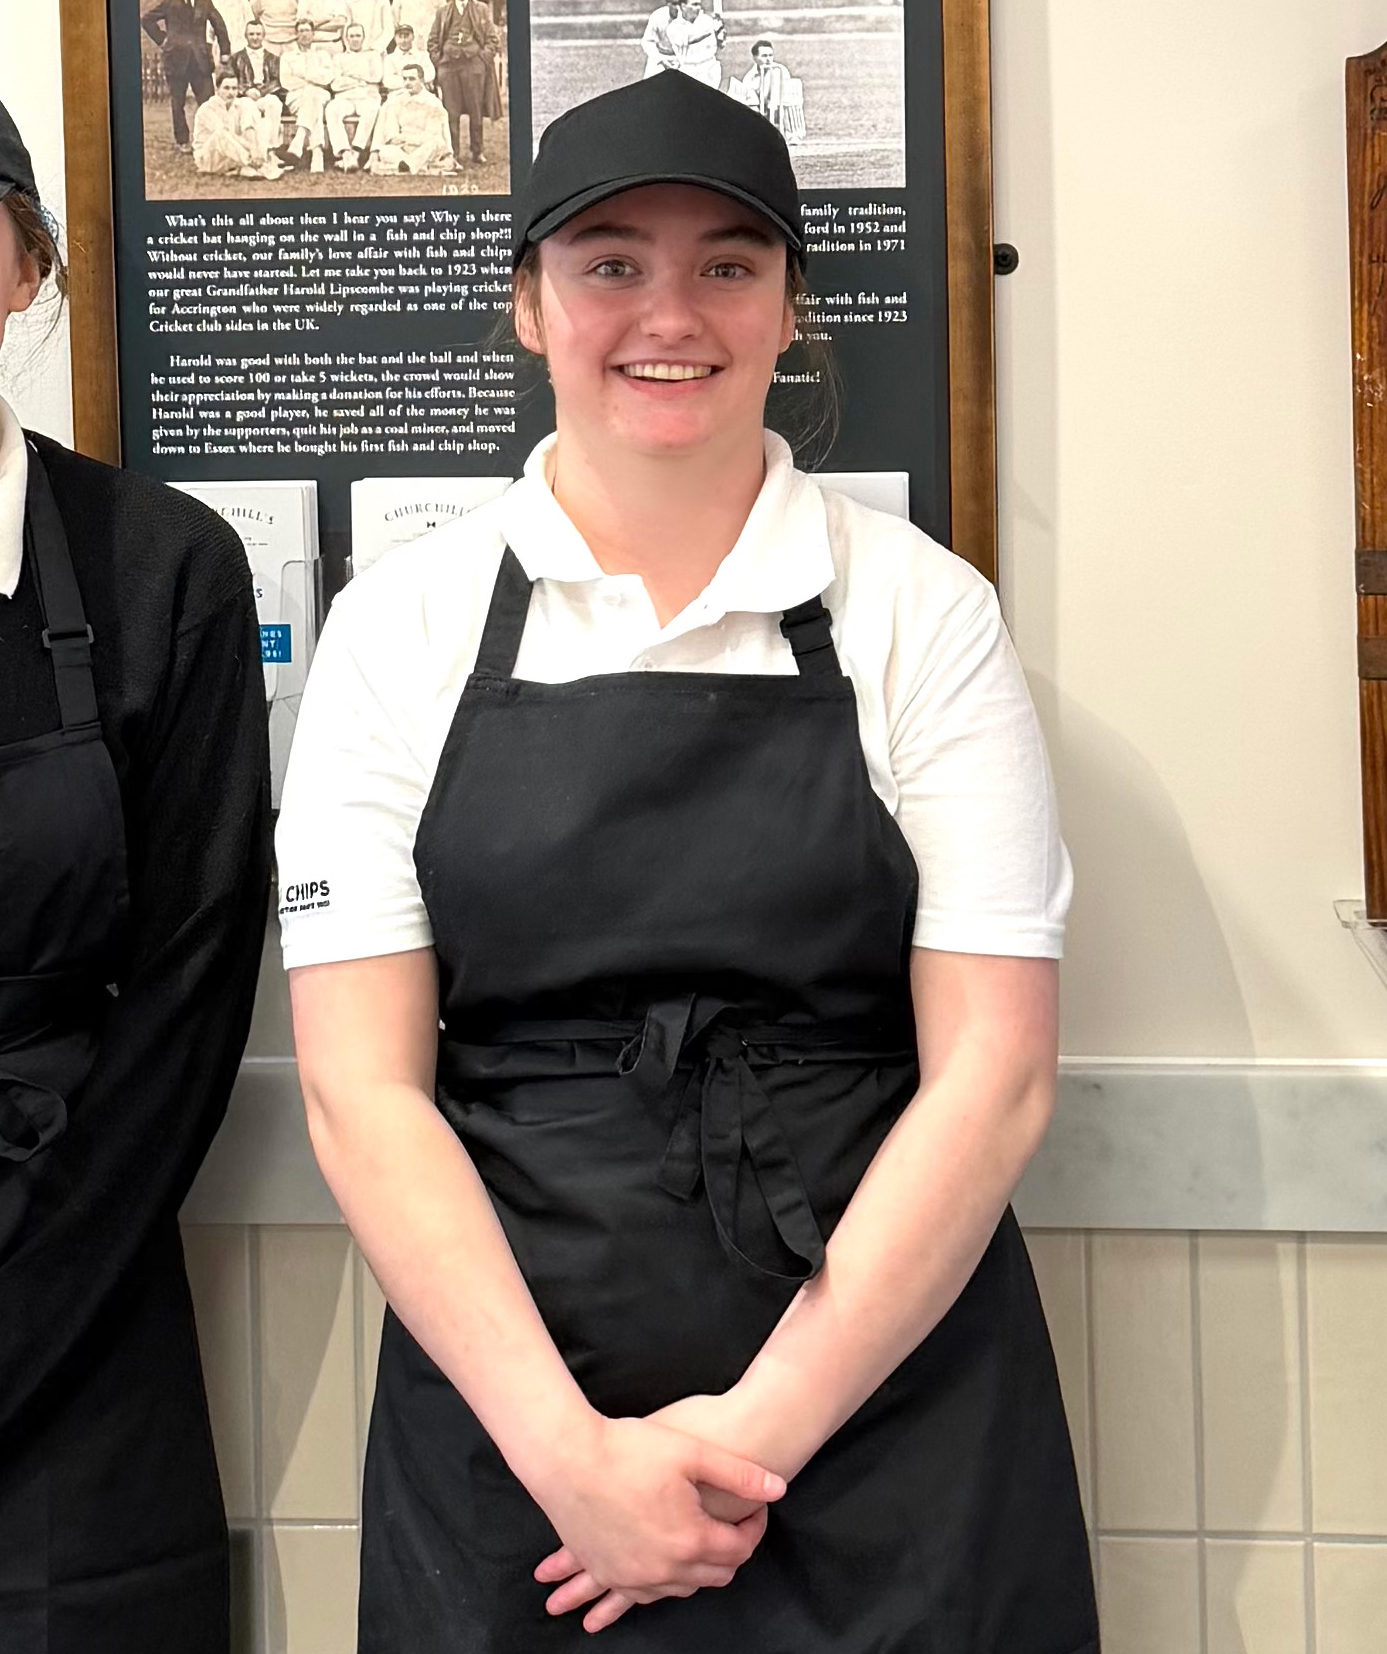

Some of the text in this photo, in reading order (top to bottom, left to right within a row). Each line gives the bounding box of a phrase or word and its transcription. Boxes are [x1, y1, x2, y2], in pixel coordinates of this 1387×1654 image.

[800, 202, 905, 219] family tradition,
[833, 222, 845, 233] in
[850, 221, 880, 233] 1952
[883, 220, 906, 232] and
[859, 239, 871, 251] in
[877, 239, 904, 251] 1971
[146, 245, 512, 263] Without cricket, our family's love affair with fish and chips
[147, 262, 512, 279] would never have started. Let me take you back to 1923 when
[148, 280, 512, 300] our great Grandfather Harold Lipscombe was playing cricket
[825, 292, 852, 305] with
[857, 291, 879, 304] fish
[884, 291, 907, 304] and
[844, 312, 874, 323] since
[878, 310, 907, 322] 1923
[773, 371, 820, 383] Fanatic!
[152, 439, 499, 456] down to Essex where he bought his first fish and chip shop.
[286, 880, 330, 903] CHIPS
